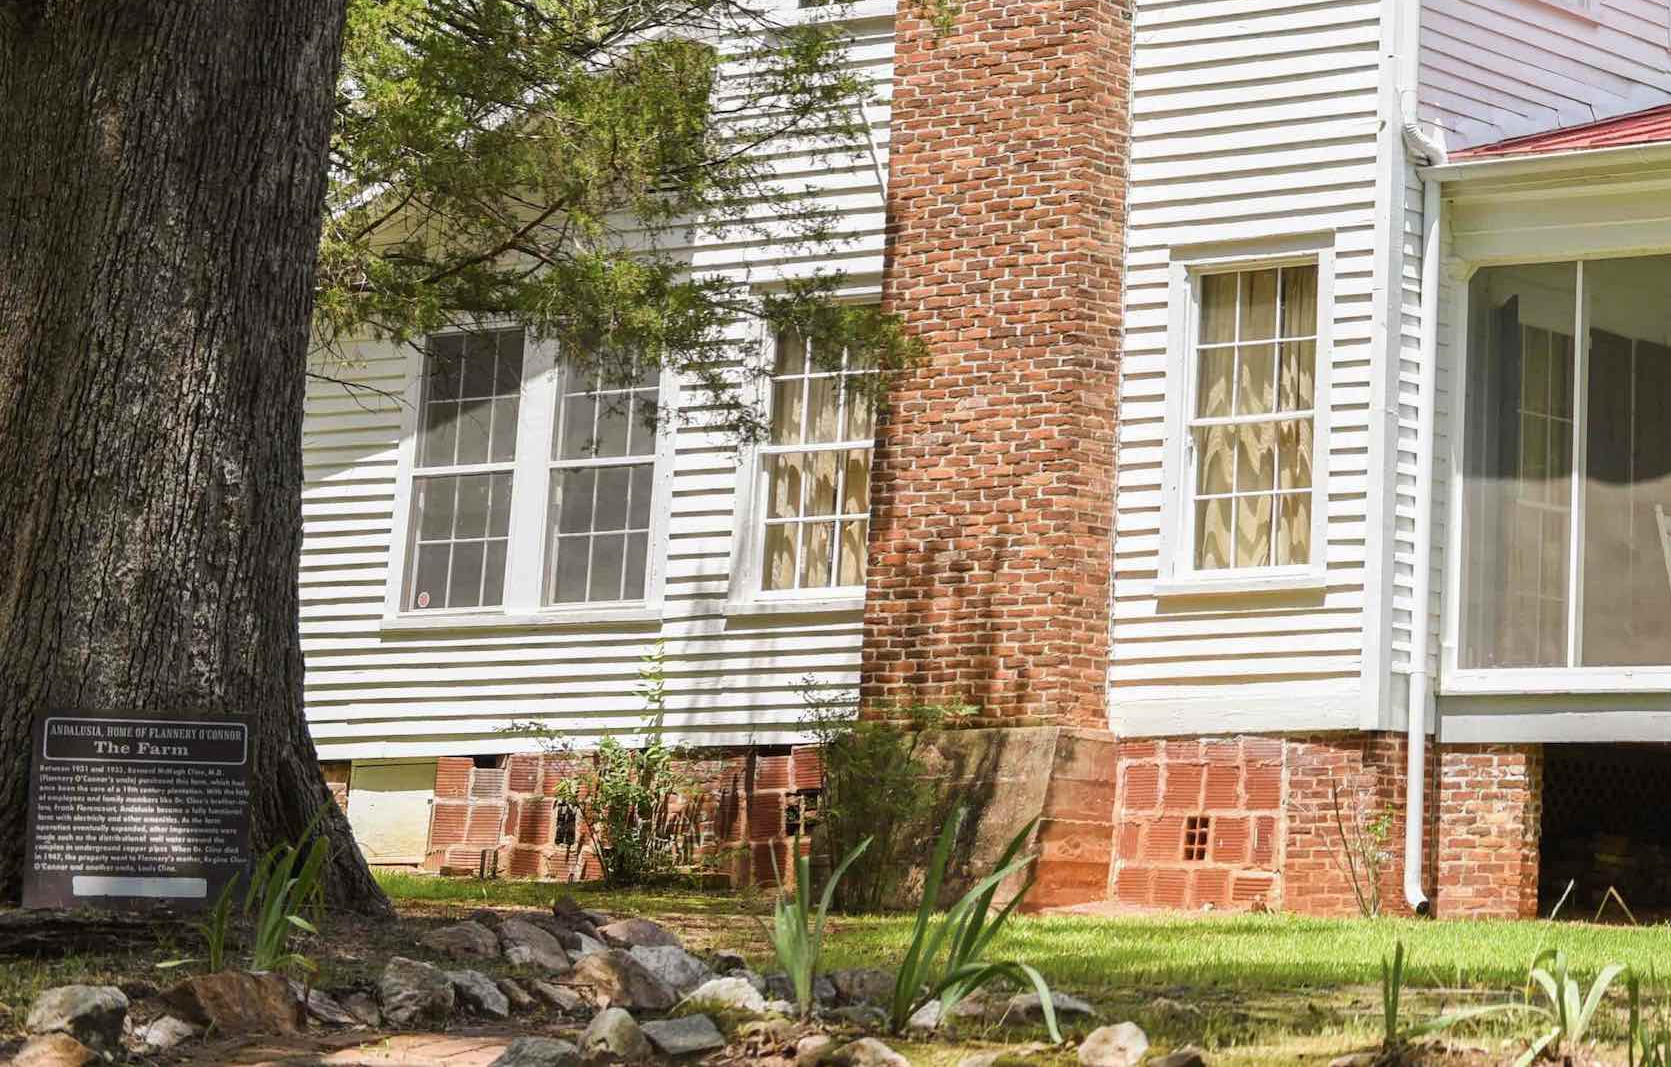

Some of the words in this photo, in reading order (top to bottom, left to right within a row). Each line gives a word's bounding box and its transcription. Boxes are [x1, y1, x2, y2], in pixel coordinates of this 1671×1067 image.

[49, 724, 104, 738] ANDALUSIA,
[107, 726, 134, 737] HOME
[136, 727, 147, 738] OF
[149, 728, 196, 739] FLANNERY
[199, 729, 241, 741] O'CONNOR
[93, 741, 130, 754] The
[136, 742, 189, 756] Farm
[103, 795, 123, 804] family
[126, 796, 158, 804] members
[120, 806, 154, 814] Andalusia
[73, 814, 105, 823] electricity
[73, 824, 108, 833] eventually
